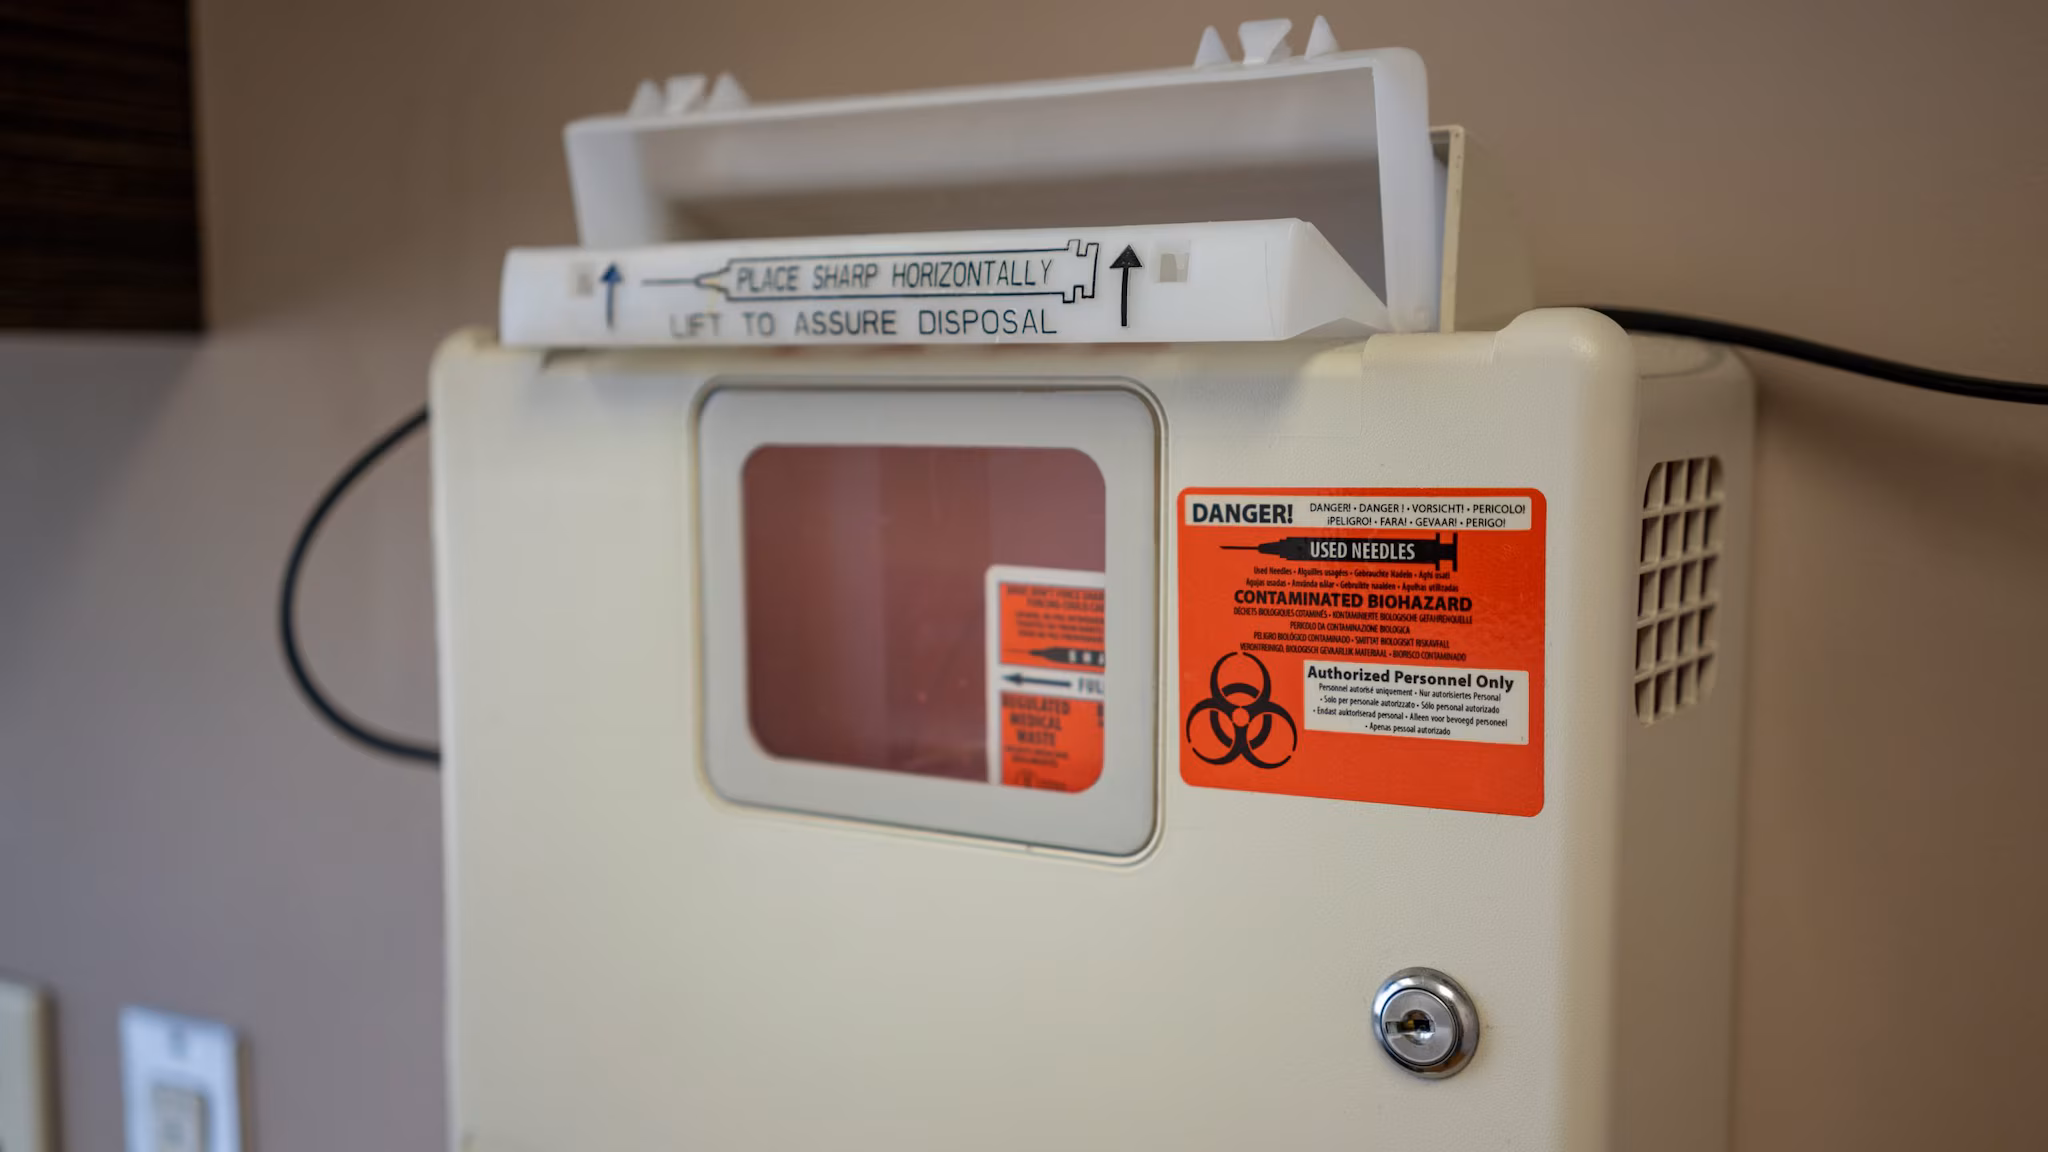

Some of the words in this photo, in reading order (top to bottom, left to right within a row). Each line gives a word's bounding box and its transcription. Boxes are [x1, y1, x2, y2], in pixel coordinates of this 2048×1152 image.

[736, 264, 799, 293] PLACE
[813, 262, 878, 291] SHARP
[892, 258, 1054, 290] HORIZONTALLY
[670, 312, 725, 338] LIFT
[742, 311, 776, 338] TO
[794, 309, 896, 337] ASSURE
[918, 307, 1058, 336] DISPOSAL
[1192, 503, 1294, 524] DANGER!
[1309, 502, 1352, 513] DANGER!
[1411, 503, 1465, 514] VORSICHT!
[1472, 504, 1526, 514] PERICOLO!
[1380, 516, 1407, 527] FARA!
[1415, 517, 1458, 528] GEVAAR!
[1466, 517, 1506, 528] PERIGO!
[1310, 542, 1348, 559] USED
[1351, 542, 1416, 561] NEEDLES
[1253, 566, 1268, 575] Used
[1269, 567, 1293, 575] Needles
[1266, 579, 1287, 587] usadas
[1371, 581, 1396, 590] naalden
[1234, 589, 1364, 608] CONTAMINATED
[1368, 593, 1473, 612] BIOHAZARD
[1379, 612, 1418, 622] BIOLOGISCHE
[1289, 621, 1317, 630] PERICOLO
[1317, 622, 1326, 630] DA
[1326, 623, 1378, 633] CONTAMINAZIONE
[1379, 625, 1410, 634] BIOLOGICA
[1253, 632, 1277, 641] PELIGRO
[1307, 634, 1351, 644] CONTAMINADO
[1285, 644, 1319, 654] BIOLOGISCH
[1420, 651, 1467, 662] CONTAMINADO
[1307, 665, 1390, 684] Authorized
[1394, 670, 1472, 688] Personnel
[1476, 675, 1514, 693] Only
[1318, 682, 1348, 693] Personnel
[1375, 686, 1413, 697] uniquement
[1419, 688, 1430, 697] Nur
[1431, 689, 1472, 700] autorisiertes
[1473, 692, 1501, 702] Personal
[1323, 695, 1337, 704] Solo
[1338, 697, 1348, 706] per
[1349, 697, 1379, 708] personale
[1380, 699, 1416, 709] autorizzato
[1421, 700, 1435, 711] Sólo
[1436, 702, 1464, 713] personal
[1465, 704, 1500, 714] autorizado
[1317, 707, 1337, 717] Endast
[1338, 708, 1376, 719] auktoriserad
[1377, 710, 1404, 721] personal
[1409, 712, 1429, 722] Alleen
[1430, 715, 1445, 723] voor
[1446, 715, 1474, 726] bevoegd
[1475, 717, 1508, 728] personeel
[1017, 729, 1056, 747] WASTE
[1369, 722, 1392, 733] Apenas
[1393, 724, 1416, 735] pessoal
[1417, 725, 1451, 736] autorizado
